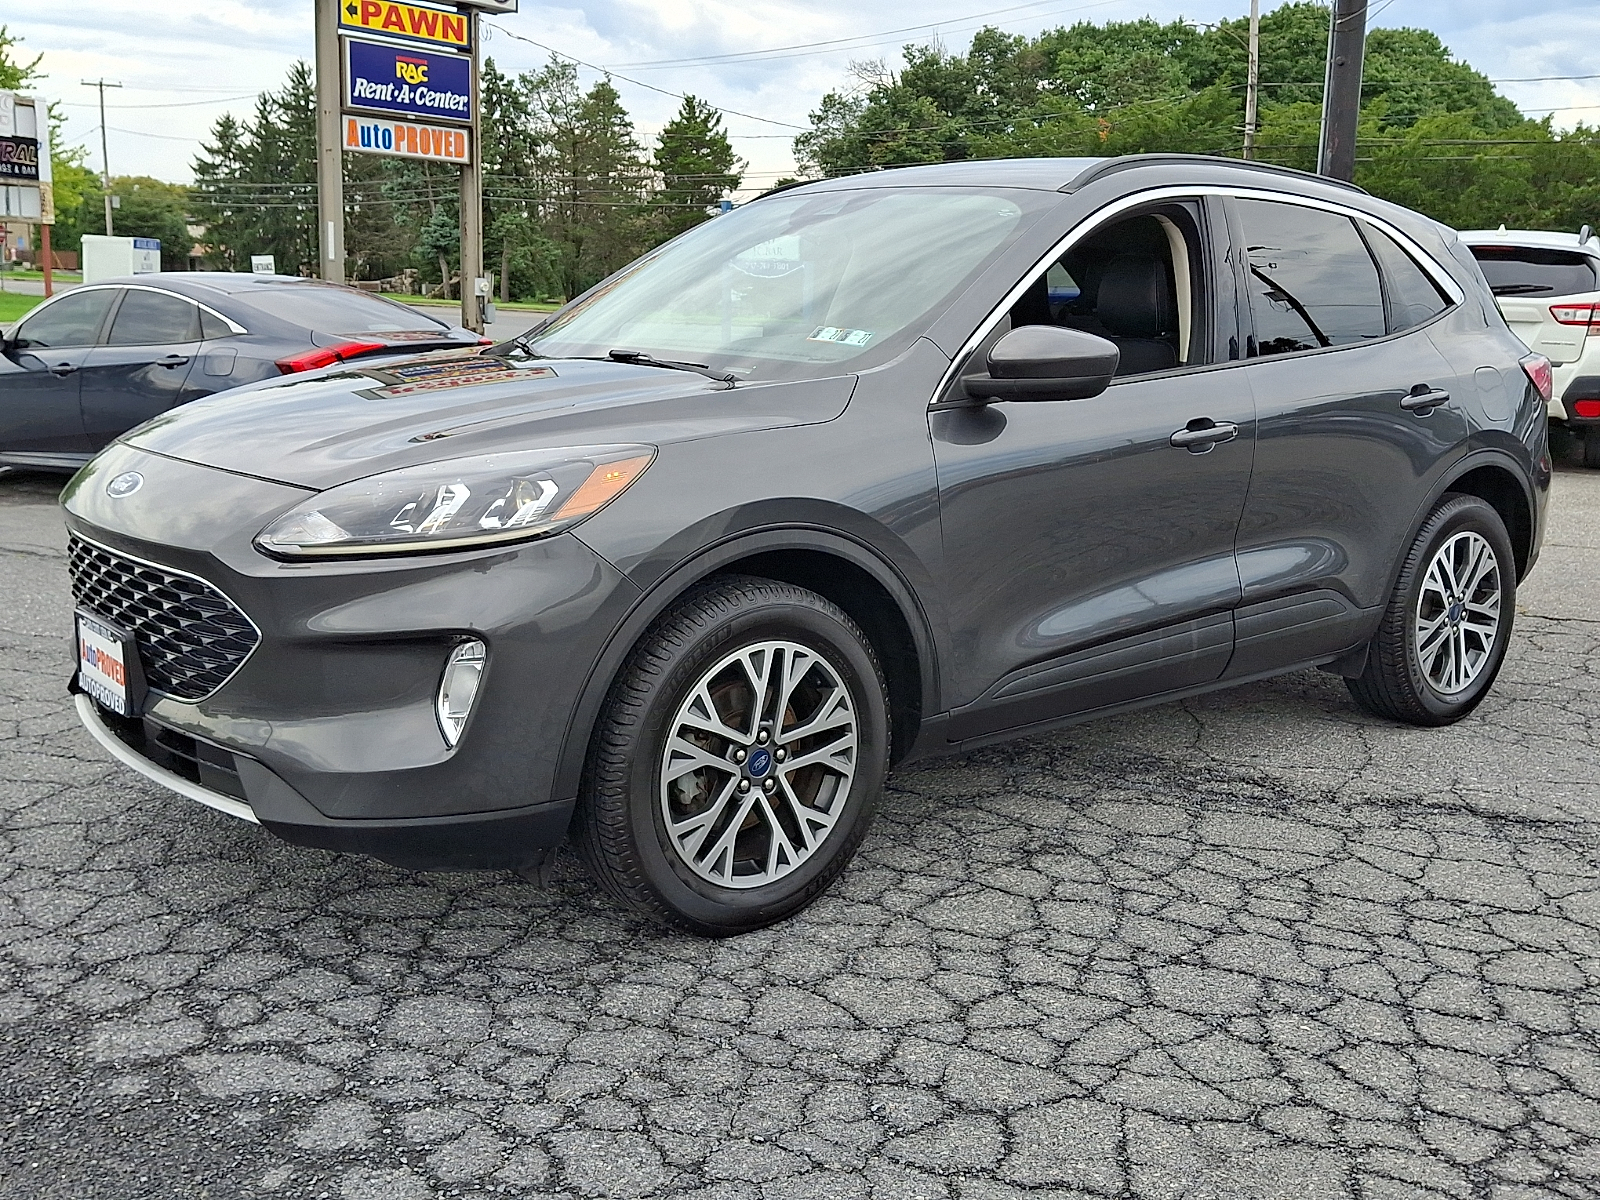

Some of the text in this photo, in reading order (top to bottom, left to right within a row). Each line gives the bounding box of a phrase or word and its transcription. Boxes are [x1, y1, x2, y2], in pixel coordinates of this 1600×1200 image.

[361, 0, 464, 42] PAWN
[395, 61, 429, 84] RAC
[0, 140, 38, 165] RAL
[346, 118, 466, 159] AutoPROVED
[79, 672, 126, 715] AUTOPROVED
